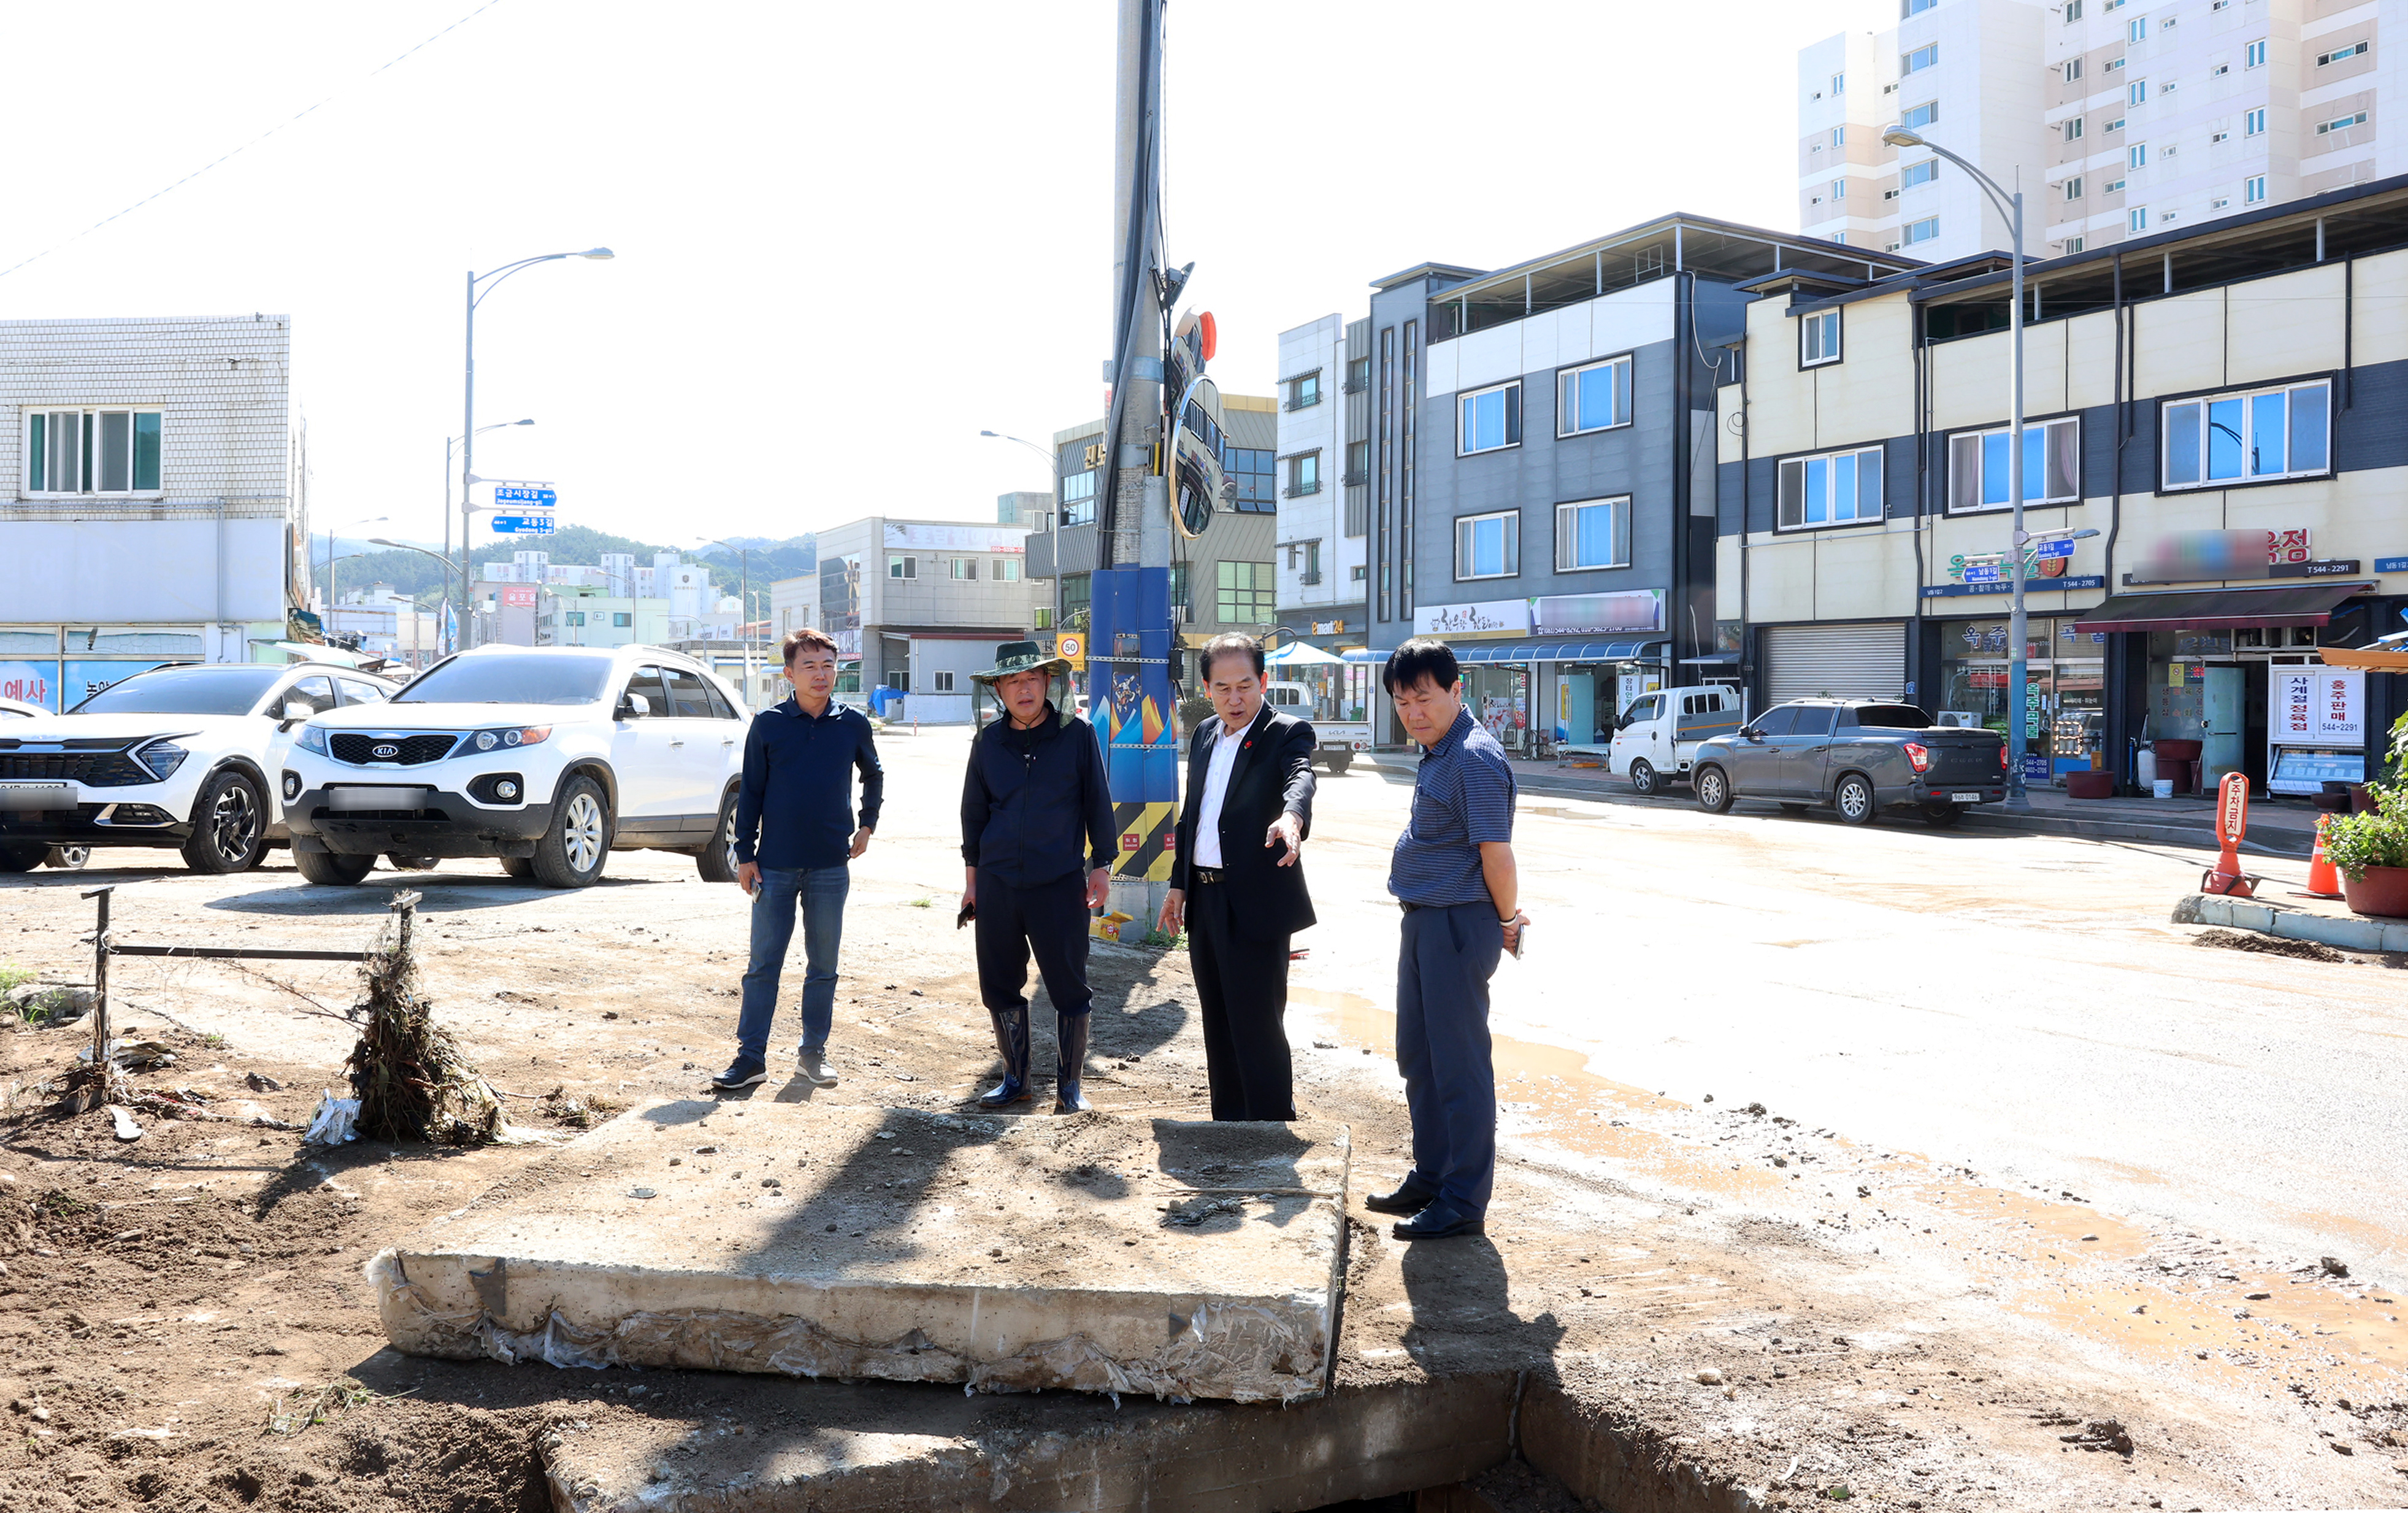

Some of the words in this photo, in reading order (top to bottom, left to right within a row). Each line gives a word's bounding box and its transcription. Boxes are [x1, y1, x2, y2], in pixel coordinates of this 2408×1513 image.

[496, 489, 539, 499] 조금시장길
[522, 518, 553, 527] 교동3길
[2039, 542, 2055, 552] 교동1길
[1979, 566, 1997, 575] 남동1길
[1312, 620, 1344, 635] emart24
[0, 679, 46, 703] 예사
[2289, 677, 2308, 731] 사계절정육점
[2330, 680, 2347, 721] 홍주판매
[2322, 723, 2357, 731] 544-2291
[2228, 784, 2241, 831] 주차금지
